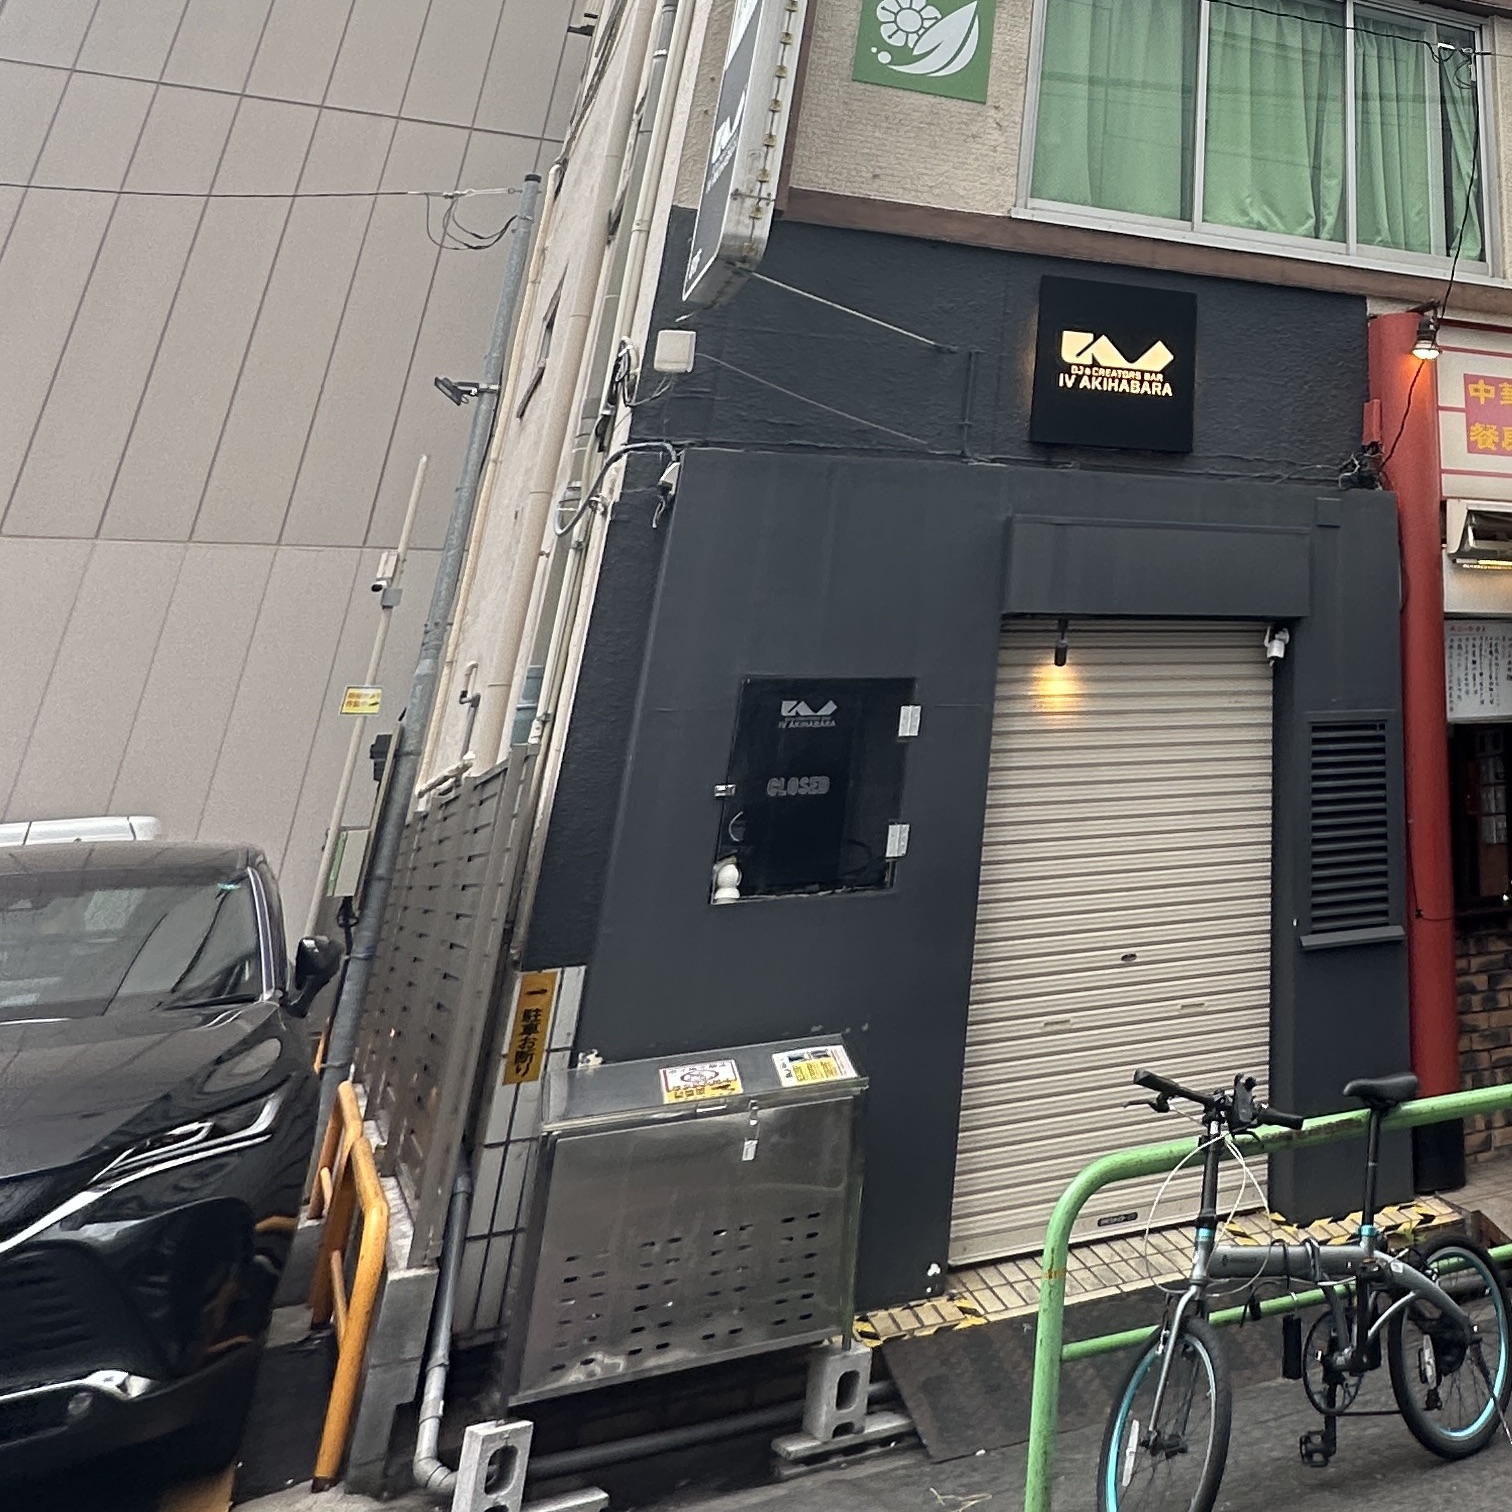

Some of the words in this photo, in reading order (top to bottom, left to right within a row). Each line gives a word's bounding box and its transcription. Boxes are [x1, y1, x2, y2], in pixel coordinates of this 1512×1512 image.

[1059, 373, 1076, 388] IV
[1080, 374, 1173, 397] AKIHABARA
[767, 776, 830, 796] CLOSED
